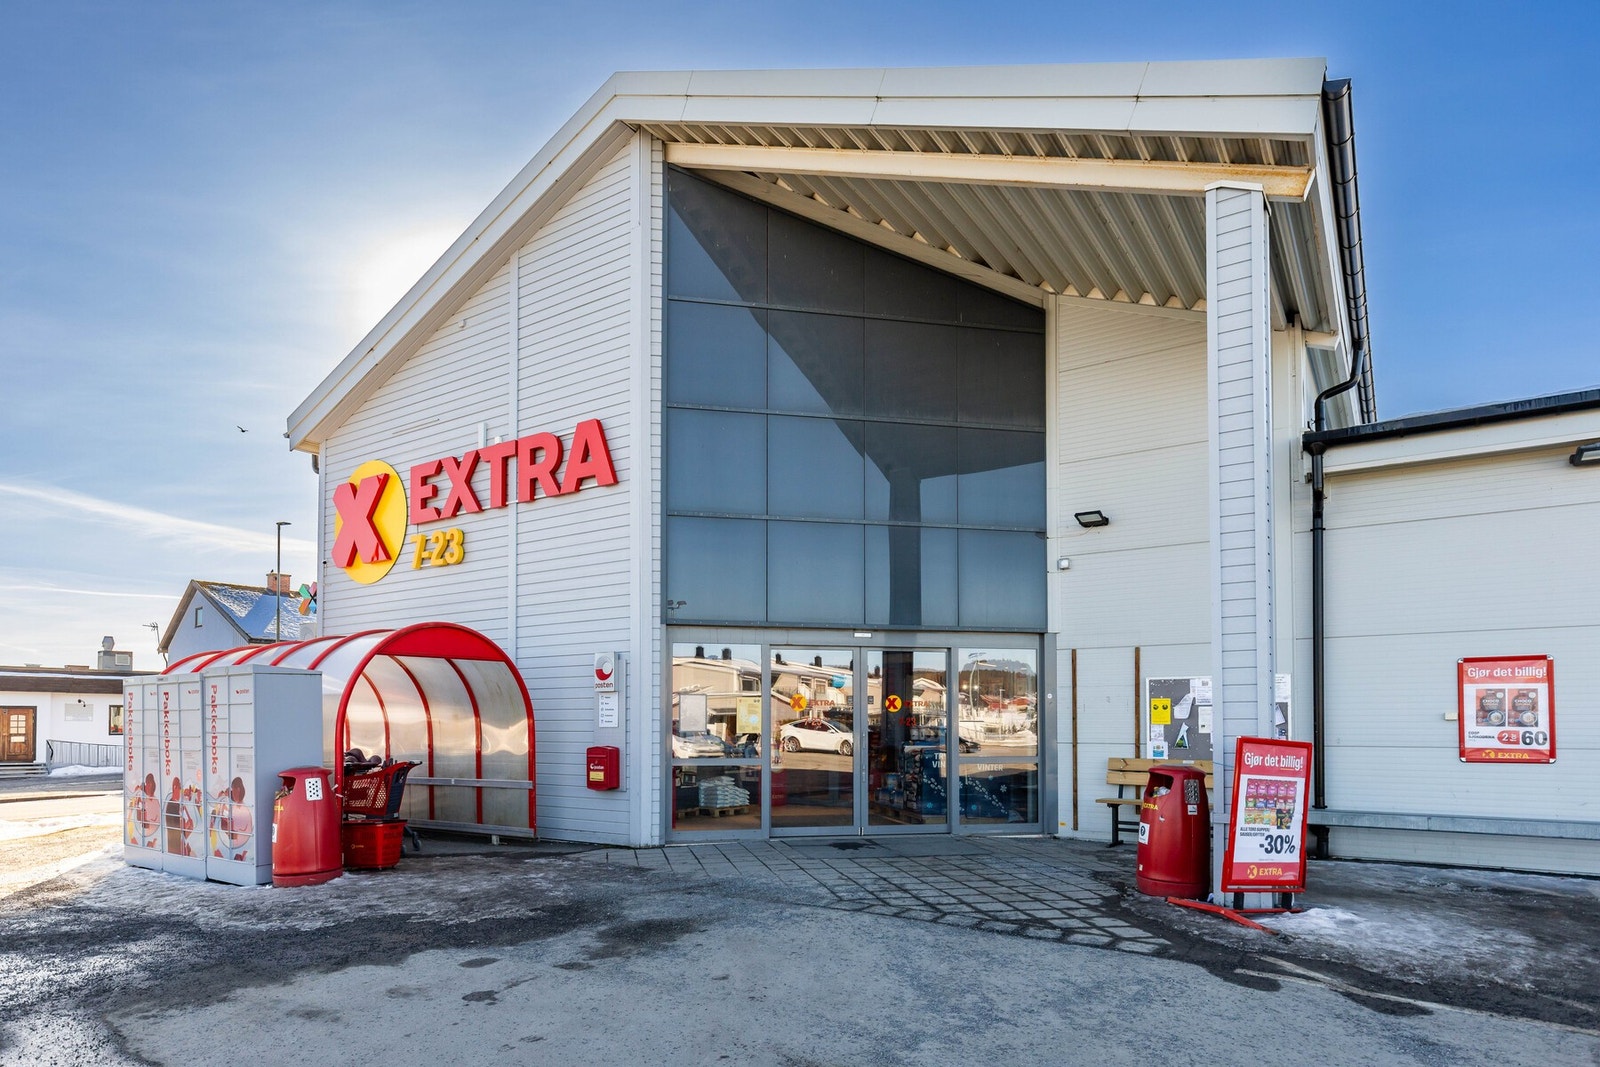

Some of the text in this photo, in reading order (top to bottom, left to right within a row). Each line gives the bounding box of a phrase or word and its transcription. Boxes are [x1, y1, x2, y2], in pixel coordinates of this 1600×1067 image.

[410, 418, 618, 524] EXTRA
[410, 528, 465, 570] 7-23
[1467, 666, 1547, 679] Gjør det billig!
[809, 699, 836, 707] EXTRA
[163, 691, 171, 776] Pakkeboks
[210, 684, 219, 775] Pakkeboks
[1502, 733, 1509, 741] 2
[1521, 730, 1548, 746] 60
[977, 763, 1004, 771] VINTER
[1244, 751, 1304, 770] Gjør det billig!
[1259, 834, 1296, 854] -30%
[1259, 867, 1283, 876] EXTRA
